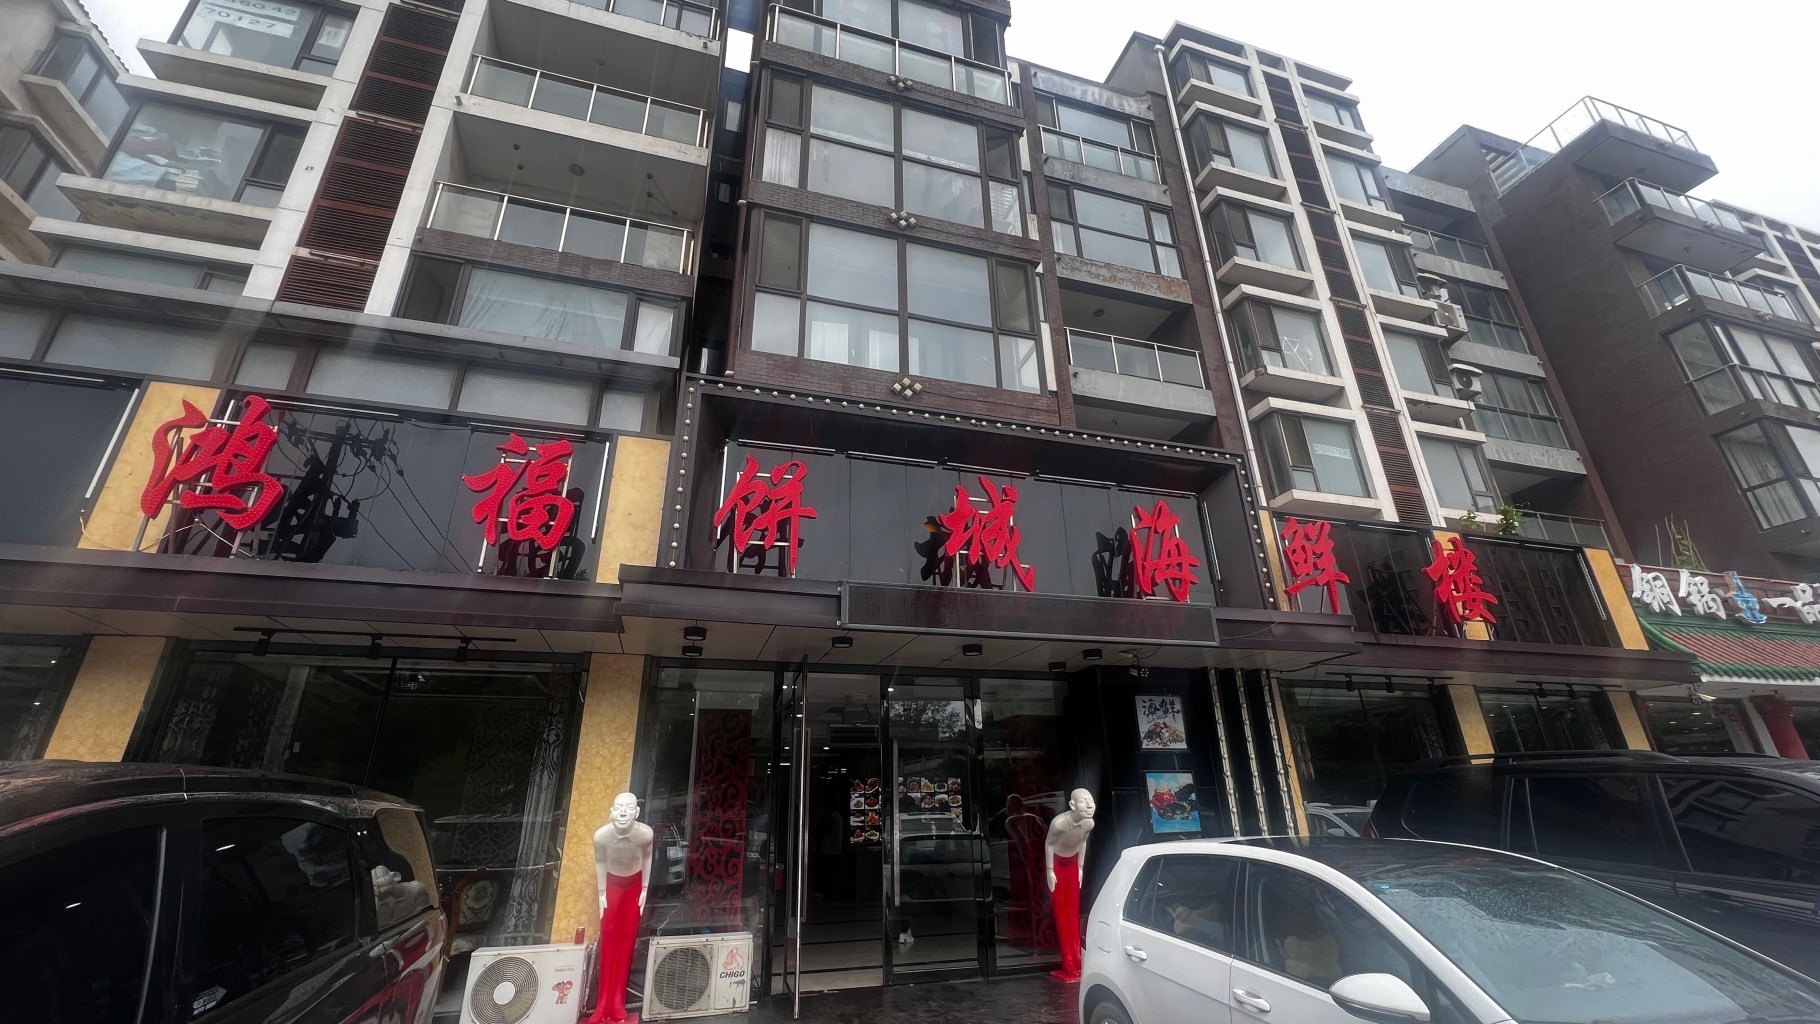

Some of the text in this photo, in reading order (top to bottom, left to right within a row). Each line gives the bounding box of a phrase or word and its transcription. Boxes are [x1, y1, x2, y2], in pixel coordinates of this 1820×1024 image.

[204, 6, 276, 29] 70127
[1141, 698, 1181, 723] 海鲜
[719, 970, 745, 979] CHIGO
